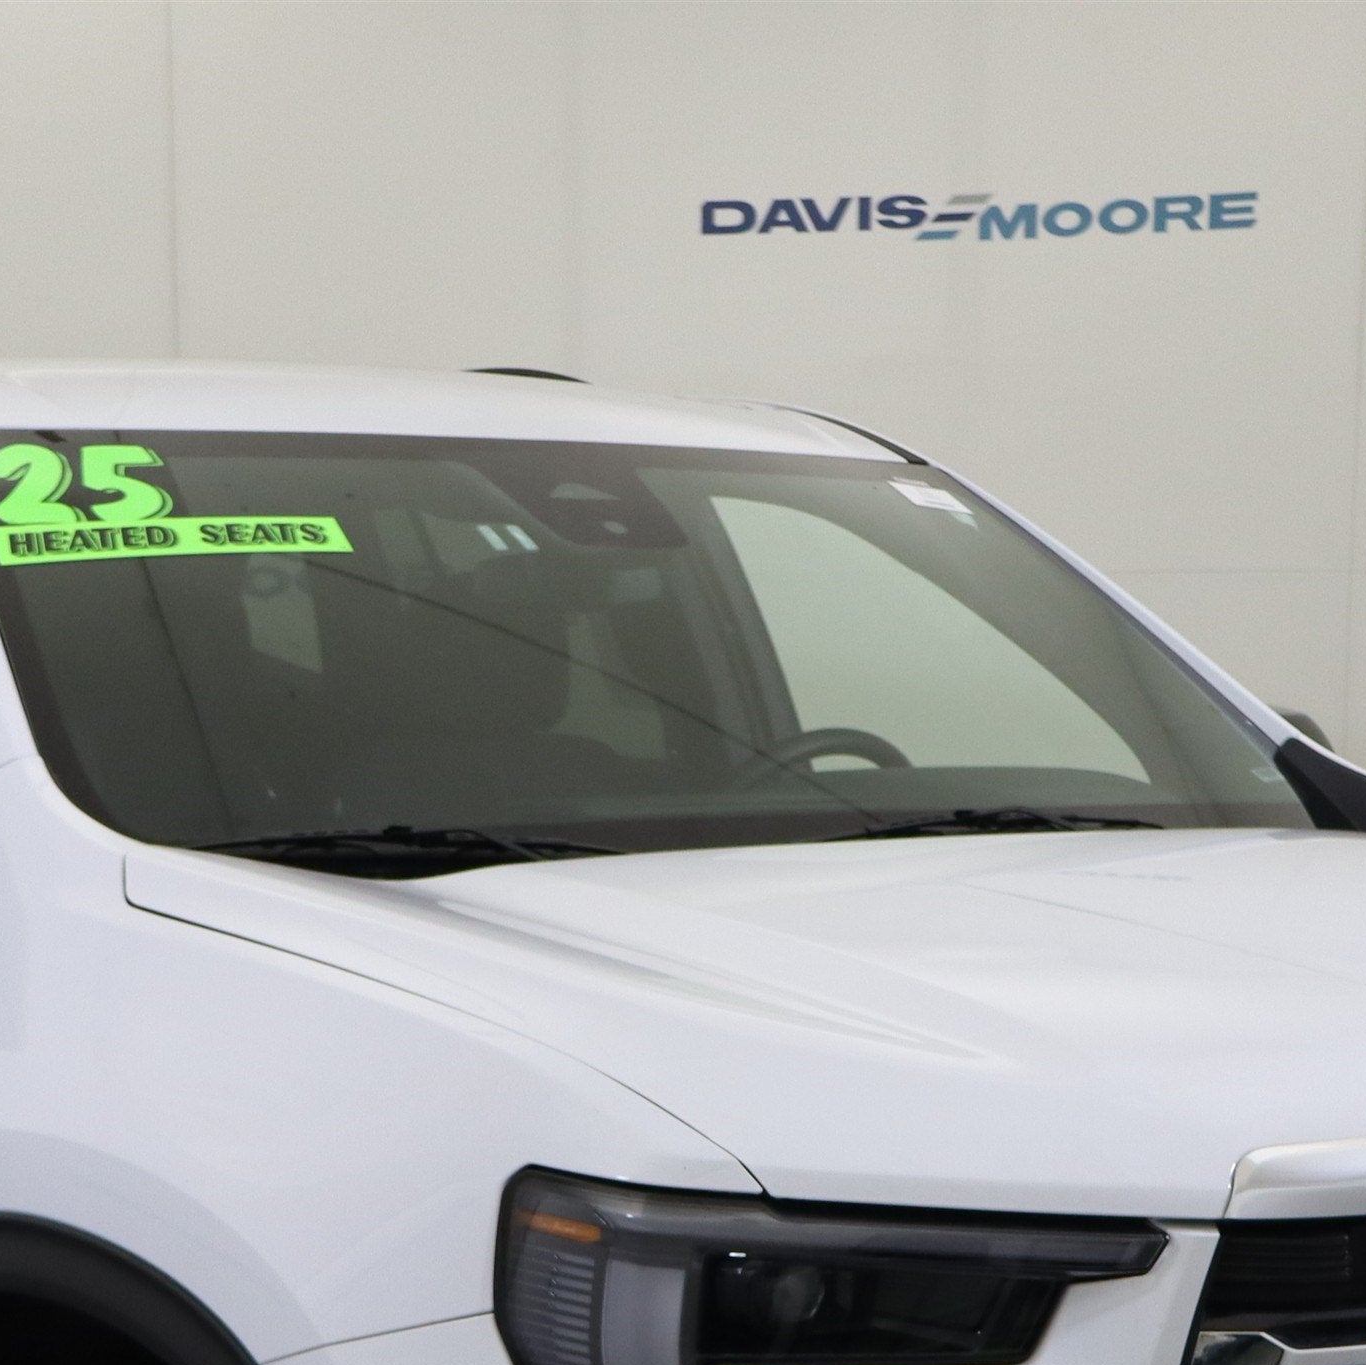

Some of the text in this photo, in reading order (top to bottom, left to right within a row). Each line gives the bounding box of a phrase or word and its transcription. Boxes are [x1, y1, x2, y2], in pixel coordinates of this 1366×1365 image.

[701, 192, 1258, 240] DAVIS MOORE
[9, 522, 328, 558] HEATED SEATS
